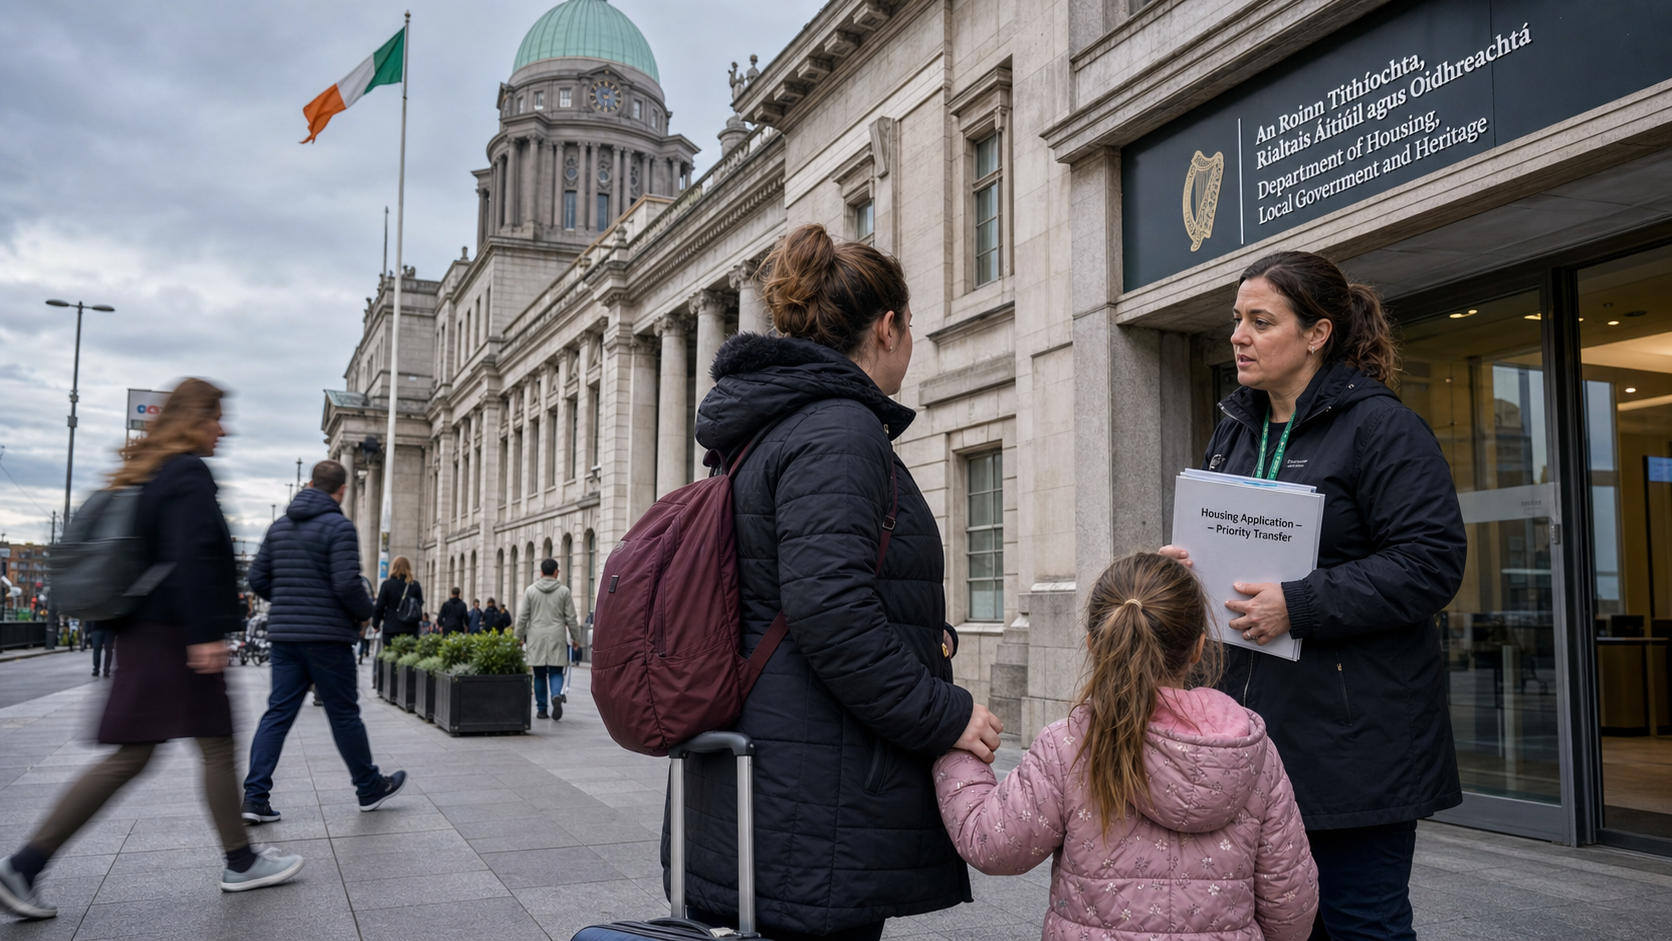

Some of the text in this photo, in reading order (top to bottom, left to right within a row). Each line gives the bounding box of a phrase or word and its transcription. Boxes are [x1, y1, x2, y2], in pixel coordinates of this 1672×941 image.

[1256, 131, 1311, 170] Rialtais
[1367, 89, 1407, 120] agus
[1410, 22, 1532, 98] Oidhreachtá
[1256, 55, 1425, 145] An Roinn Tithíochta,
[1258, 110, 1440, 200] Department of Housing,
[1259, 194, 1294, 225] Local
[1383, 144, 1412, 173] and
[1415, 117, 1487, 160] Heritage
[1201, 507, 1239, 523] Housing
[1240, 514, 1294, 529] Application
[1216, 524, 1251, 539] Priority
[1253, 529, 1292, 542] Transfer
